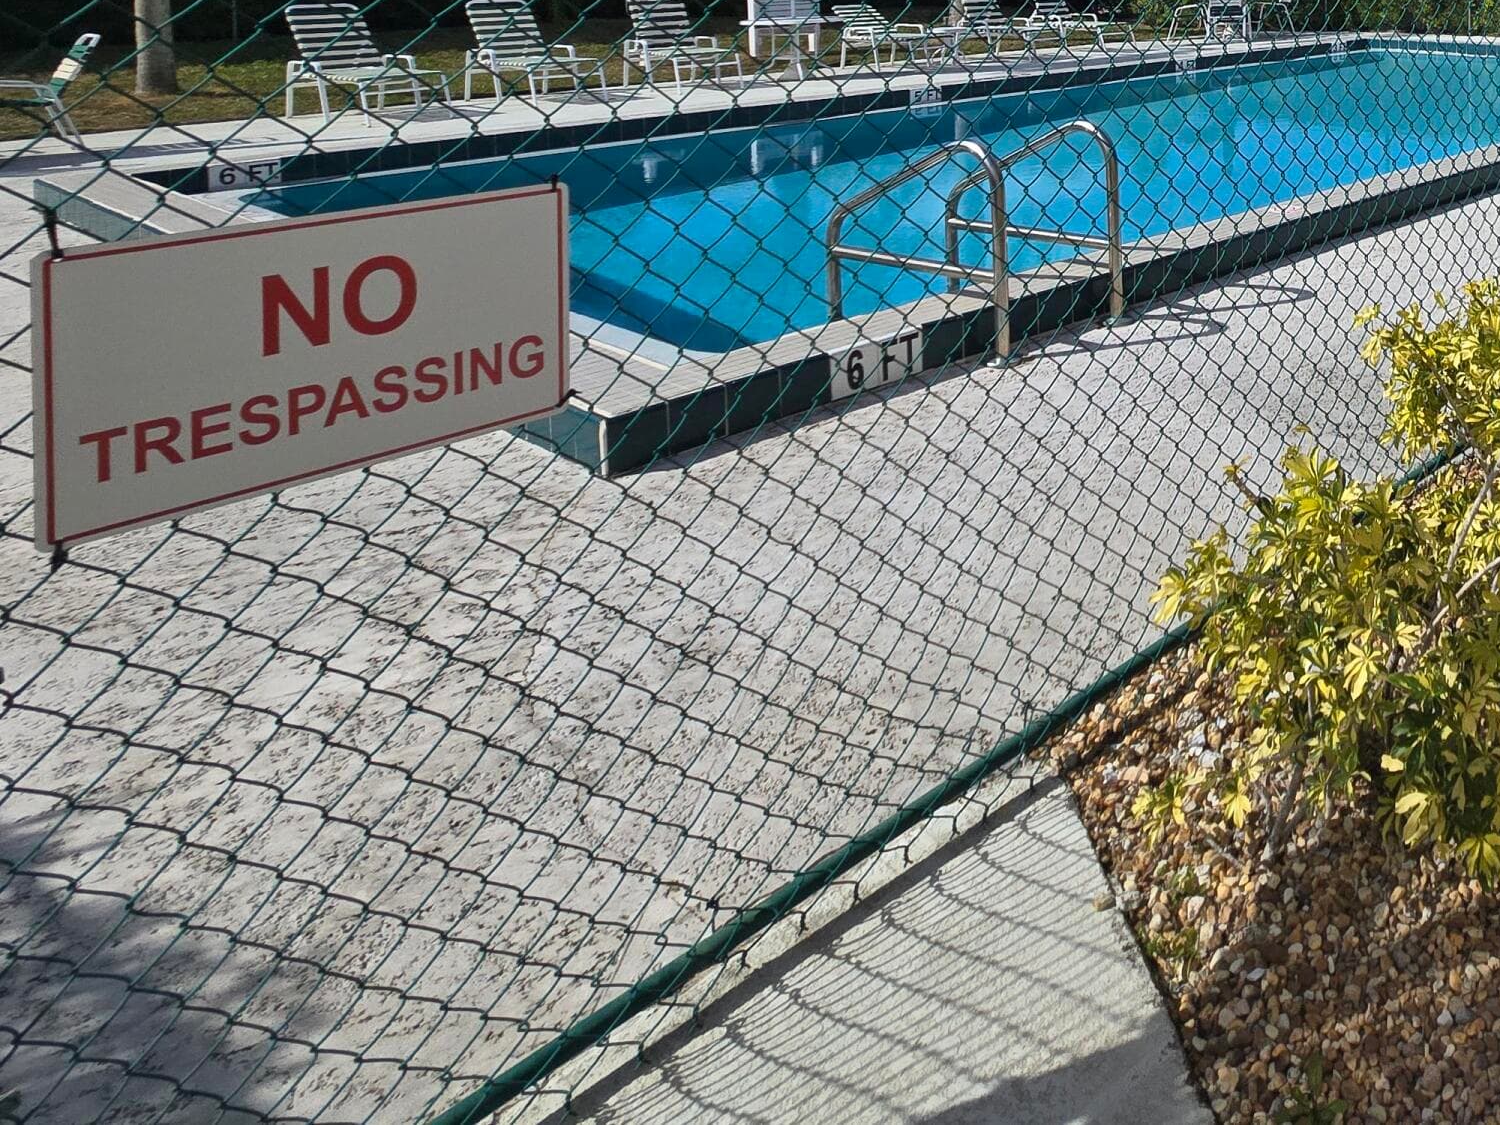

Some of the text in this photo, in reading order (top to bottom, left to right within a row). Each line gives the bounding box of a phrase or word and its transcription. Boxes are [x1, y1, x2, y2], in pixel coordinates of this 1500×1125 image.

[219, 167, 236, 185] 6
[261, 255, 418, 357] NO
[847, 332, 919, 390] 6 FT
[79, 334, 545, 483] TRESPASSING
